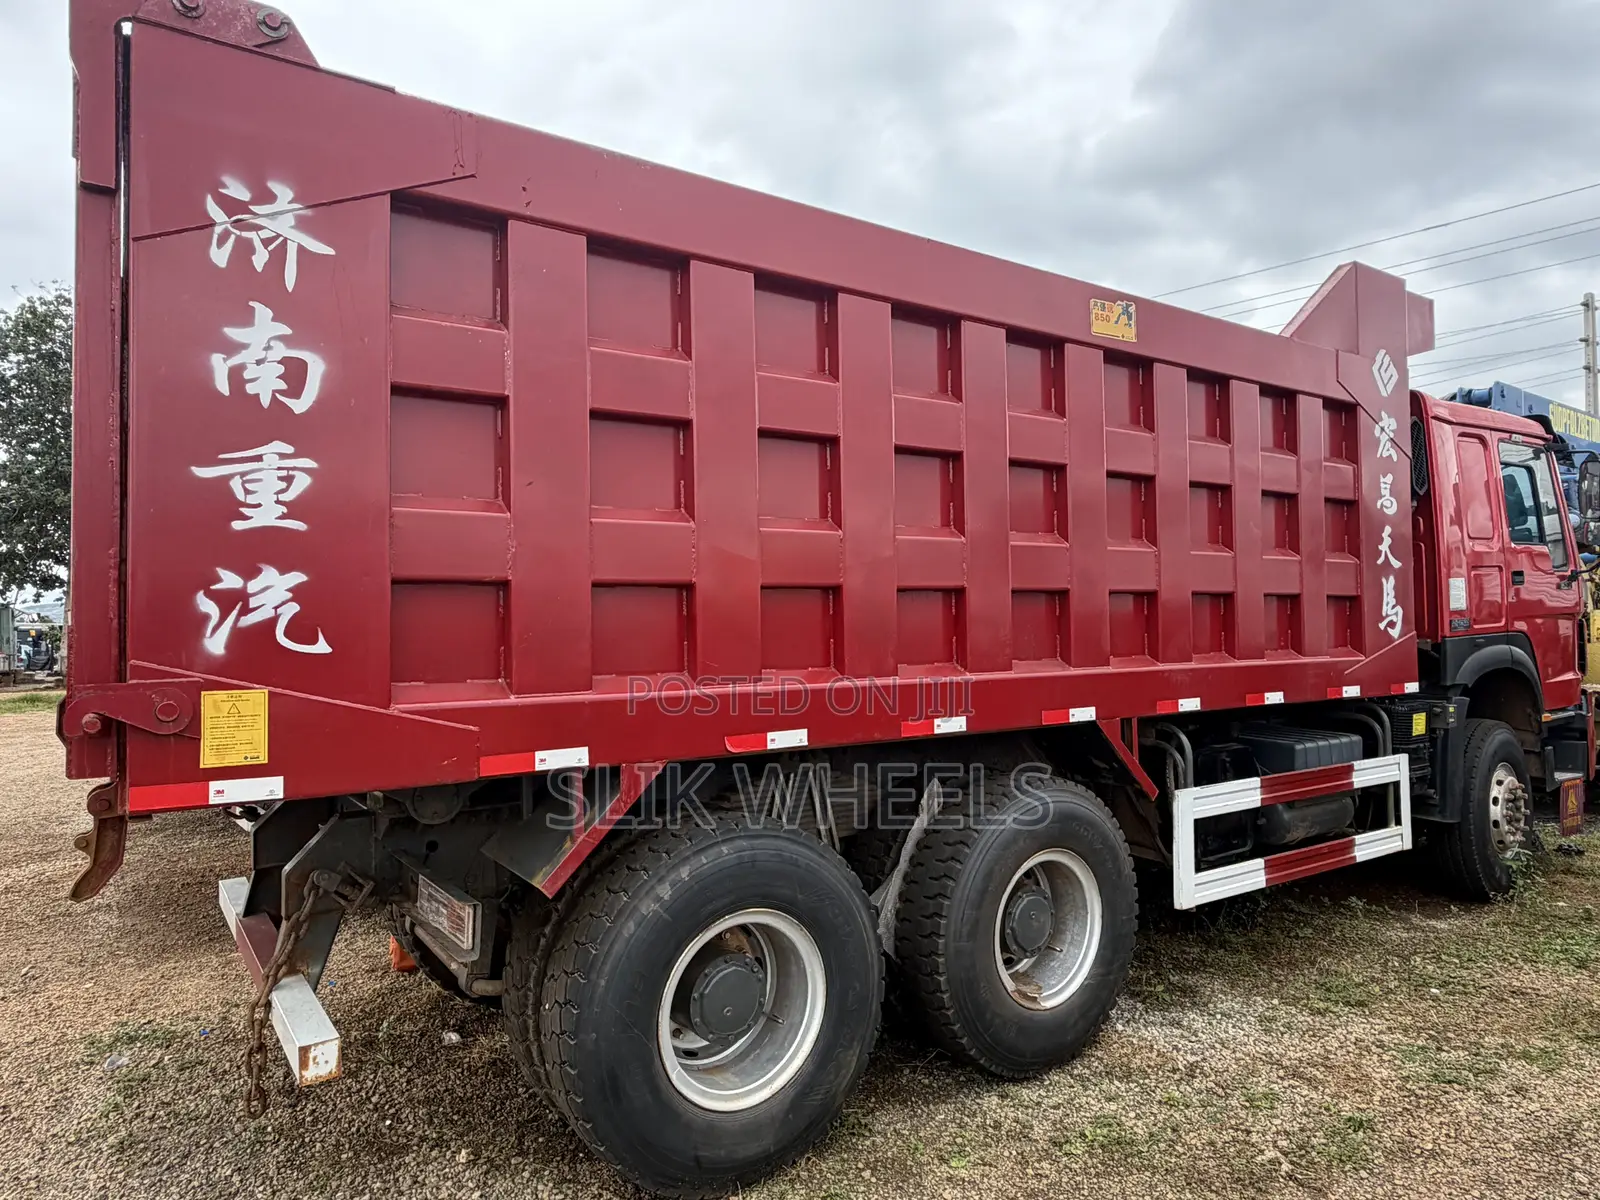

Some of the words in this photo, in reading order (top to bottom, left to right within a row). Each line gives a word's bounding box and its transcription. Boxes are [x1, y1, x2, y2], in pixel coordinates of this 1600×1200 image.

[191, 176, 336, 656] 济南重汽
[1094, 312, 1111, 323] 850
